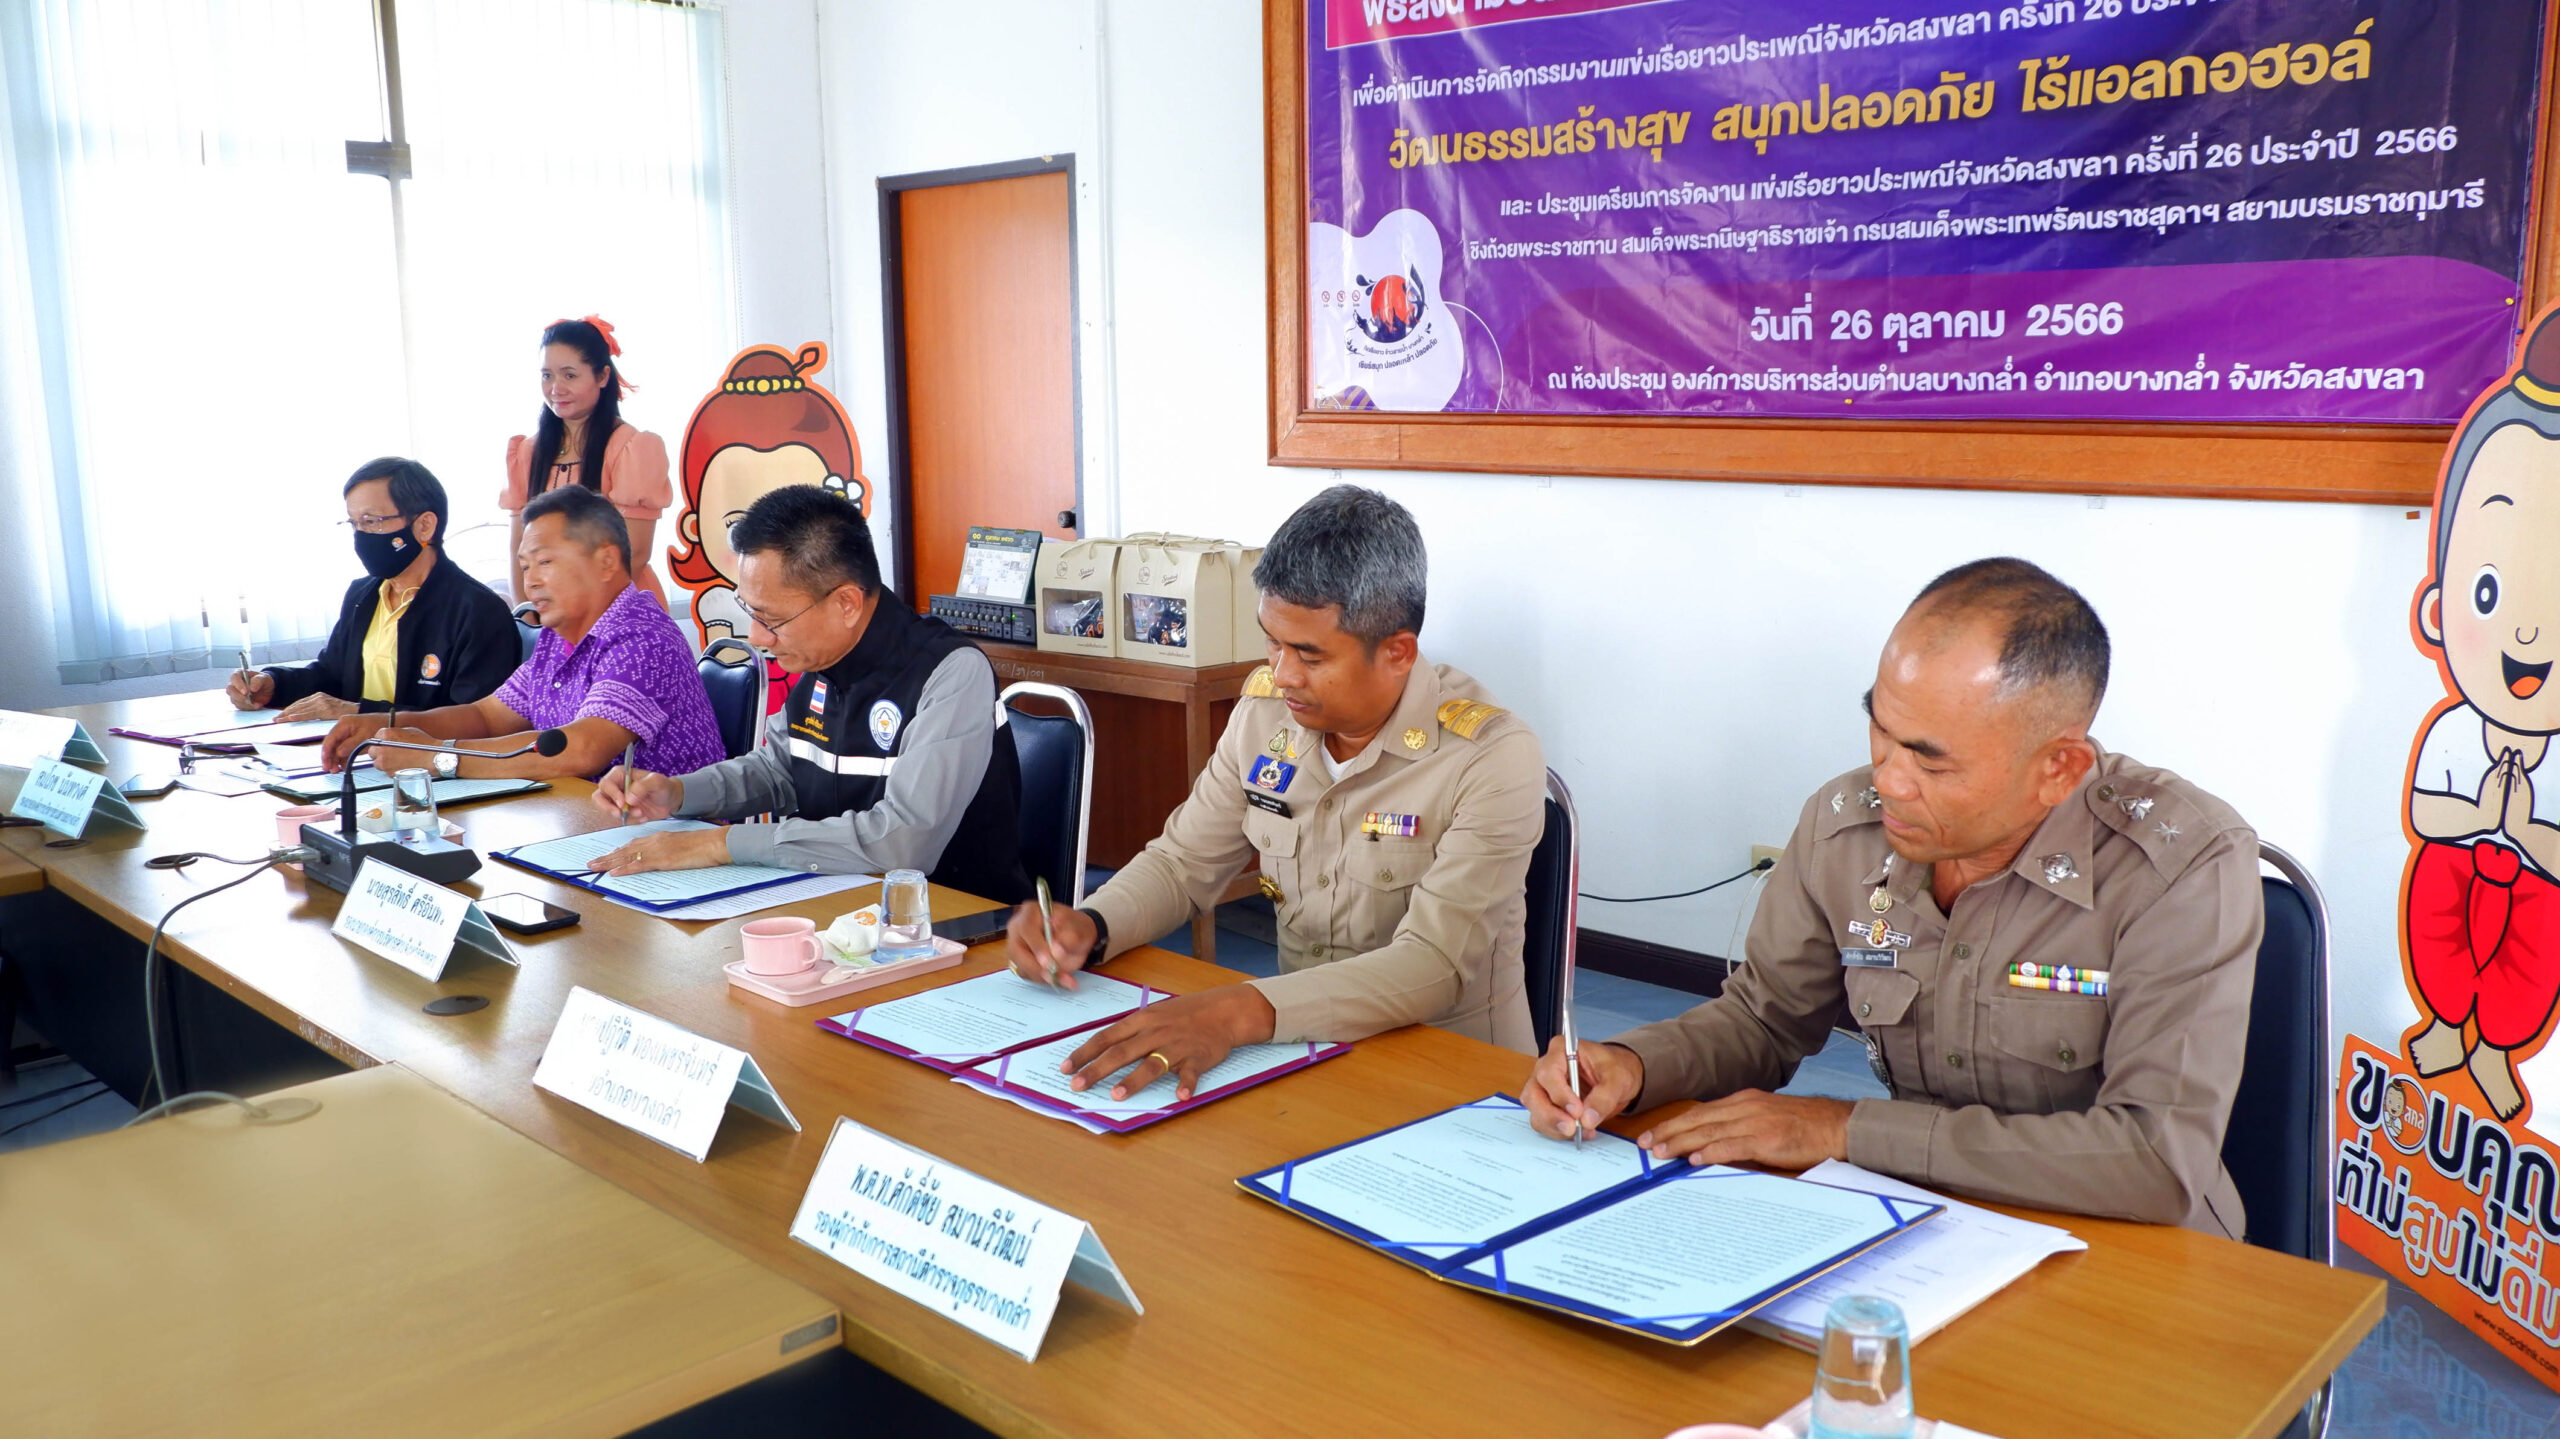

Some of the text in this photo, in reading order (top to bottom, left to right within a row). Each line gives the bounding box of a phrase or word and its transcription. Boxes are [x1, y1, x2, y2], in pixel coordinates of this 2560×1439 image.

[1353, 12, 1991, 106] เพื่อดำเนินการจัดกิจกรรมงานแข่งเรือยาวประเพณีจังหวัดสงขลา
[1389, 18, 2374, 169] วัฒนธรรมสร้างสุข สนุกปลอดภัย ไร้แอลกอฮอล์
[1501, 126, 2458, 220] และ ประชุมเตรียมการจัดงาน แข่งเรือยาวประเพณีจังหวัดสงขลา ครั้งที่ 26 ประจำปี 2566
[1470, 179, 2485, 260] ชิงถ้วยพระราชทาน สมเด็จพระกนิษฐาธิราชเจ้า กรมสมเด็จพระเทพรัตนราชสุดาฯ สยามบรมราชกุมารี
[1751, 292, 2123, 352] วันที่ 26 ตุลาคม 2566
[1549, 354, 2424, 396] ณ ห้องประชุม องค์การบริหารส่วนตำบลบางกล่ำ อำเภอบางกล่ำ จังหวัดสงขลา
[941, 1203, 1042, 1268] สมานวิวัฒน์
